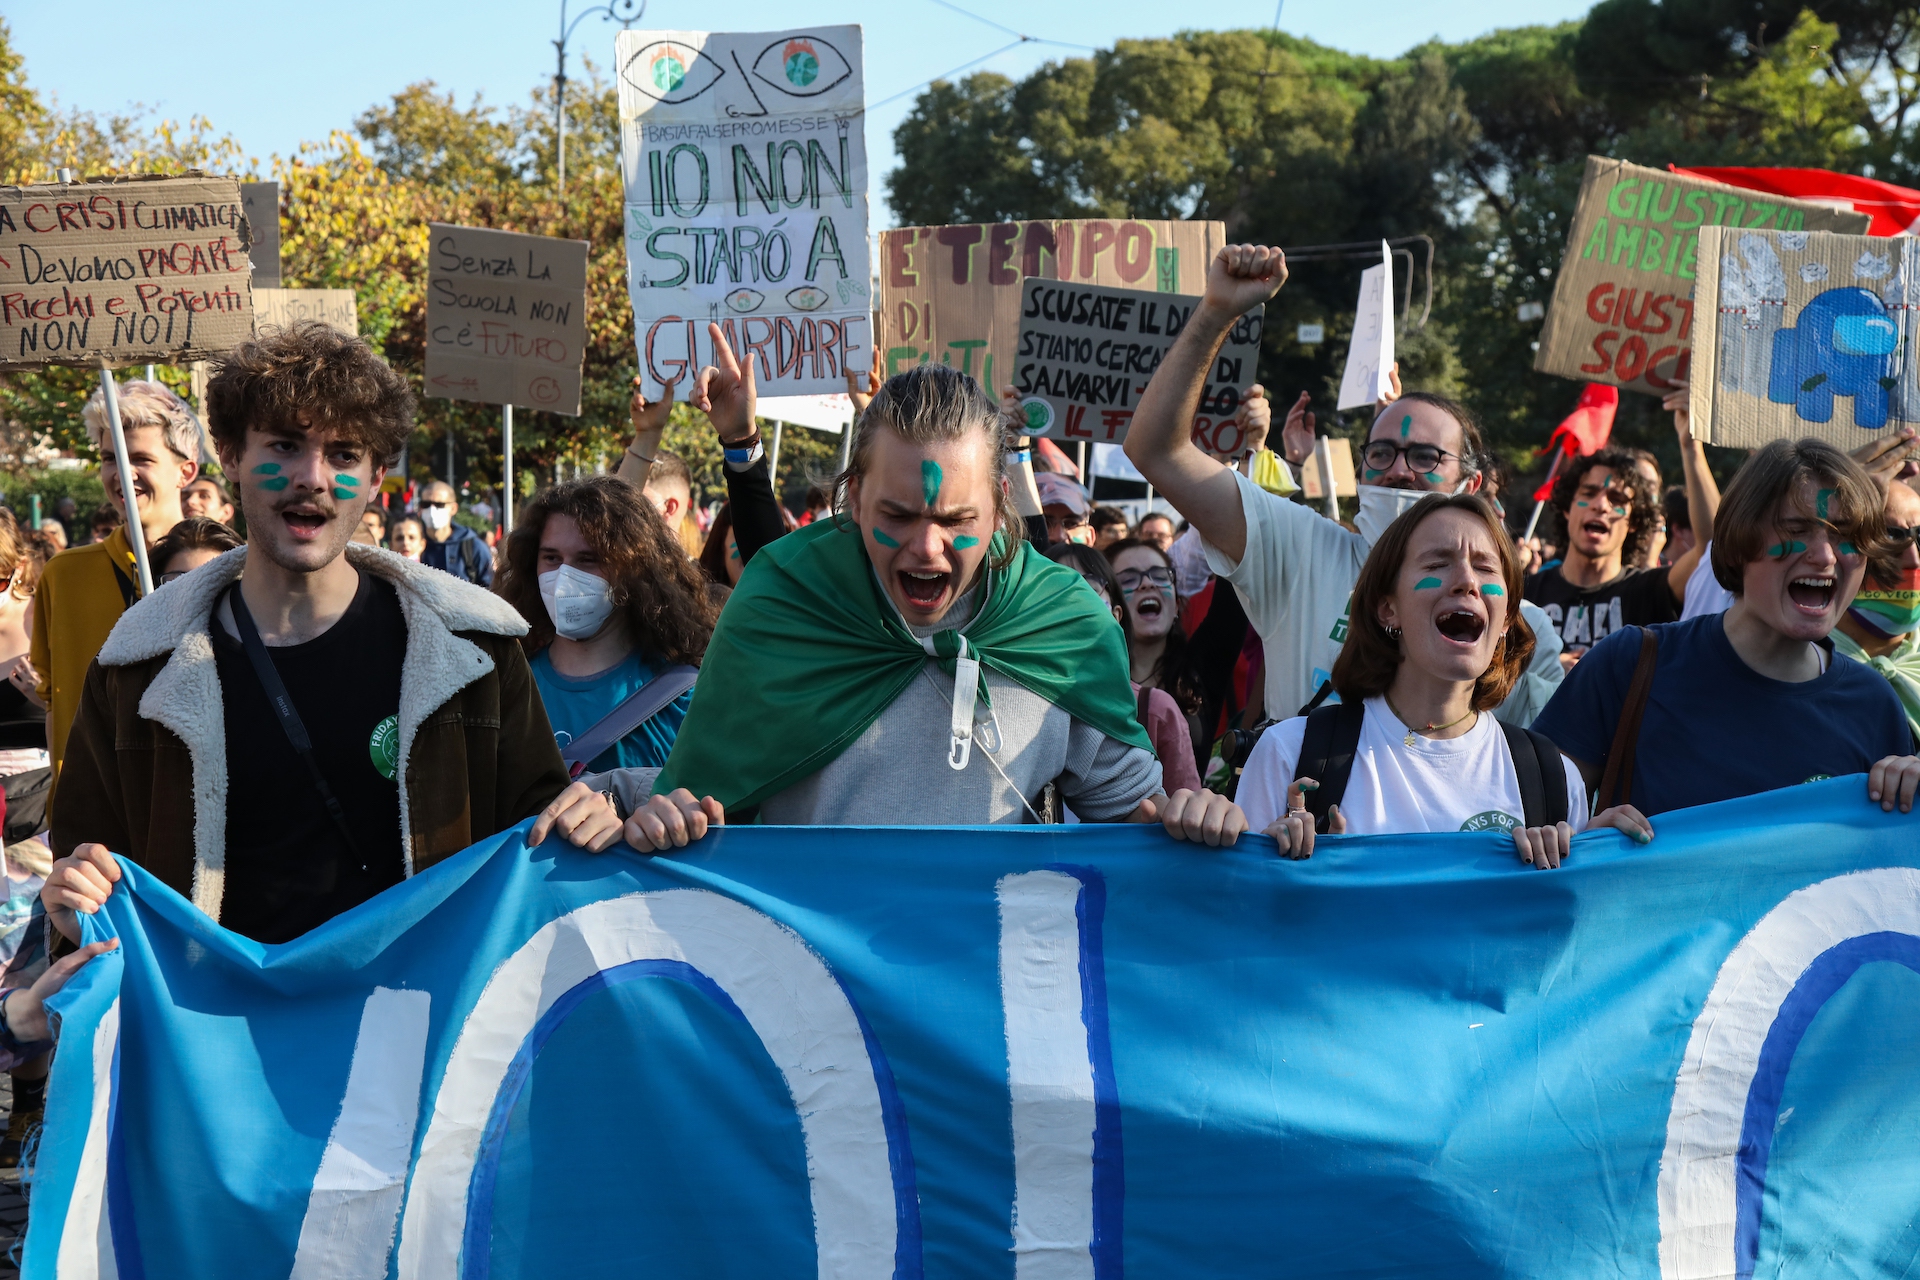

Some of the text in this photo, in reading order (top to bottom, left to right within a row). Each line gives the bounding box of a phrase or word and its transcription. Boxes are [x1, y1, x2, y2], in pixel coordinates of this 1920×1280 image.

[649, 137, 853, 218] IO NON
[24, 196, 127, 233] CRISI
[133, 201, 242, 231] CLIMATICA
[138, 236, 243, 279] PAGARE
[646, 216, 849, 288] STARÓ A
[937, 220, 1157, 285] TEMPO
[1582, 217, 1697, 279] AMBIE
[1, 286, 95, 326] Ricchi
[105, 297, 129, 316] e
[433, 279, 571, 325] SCUOLA NON
[899, 299, 932, 343] DI
[1025, 286, 1136, 332] SCUSATE
[1139, 302, 1161, 335] IL
[1586, 282, 1694, 340] GIUST
[20, 318, 90, 357] NON
[476, 322, 567, 362] FUTURO
[1019, 330, 1093, 364] STIAMO
[1216, 356, 1242, 383] DI
[1581, 330, 1691, 388] SOCI
[1017, 363, 1130, 407] SALVARVI
[1065, 404, 1092, 438] IL
[276, 695, 290, 718] instax
[371, 715, 398, 747] FRIDAY
[1463, 813, 1514, 832] AYS FOR
